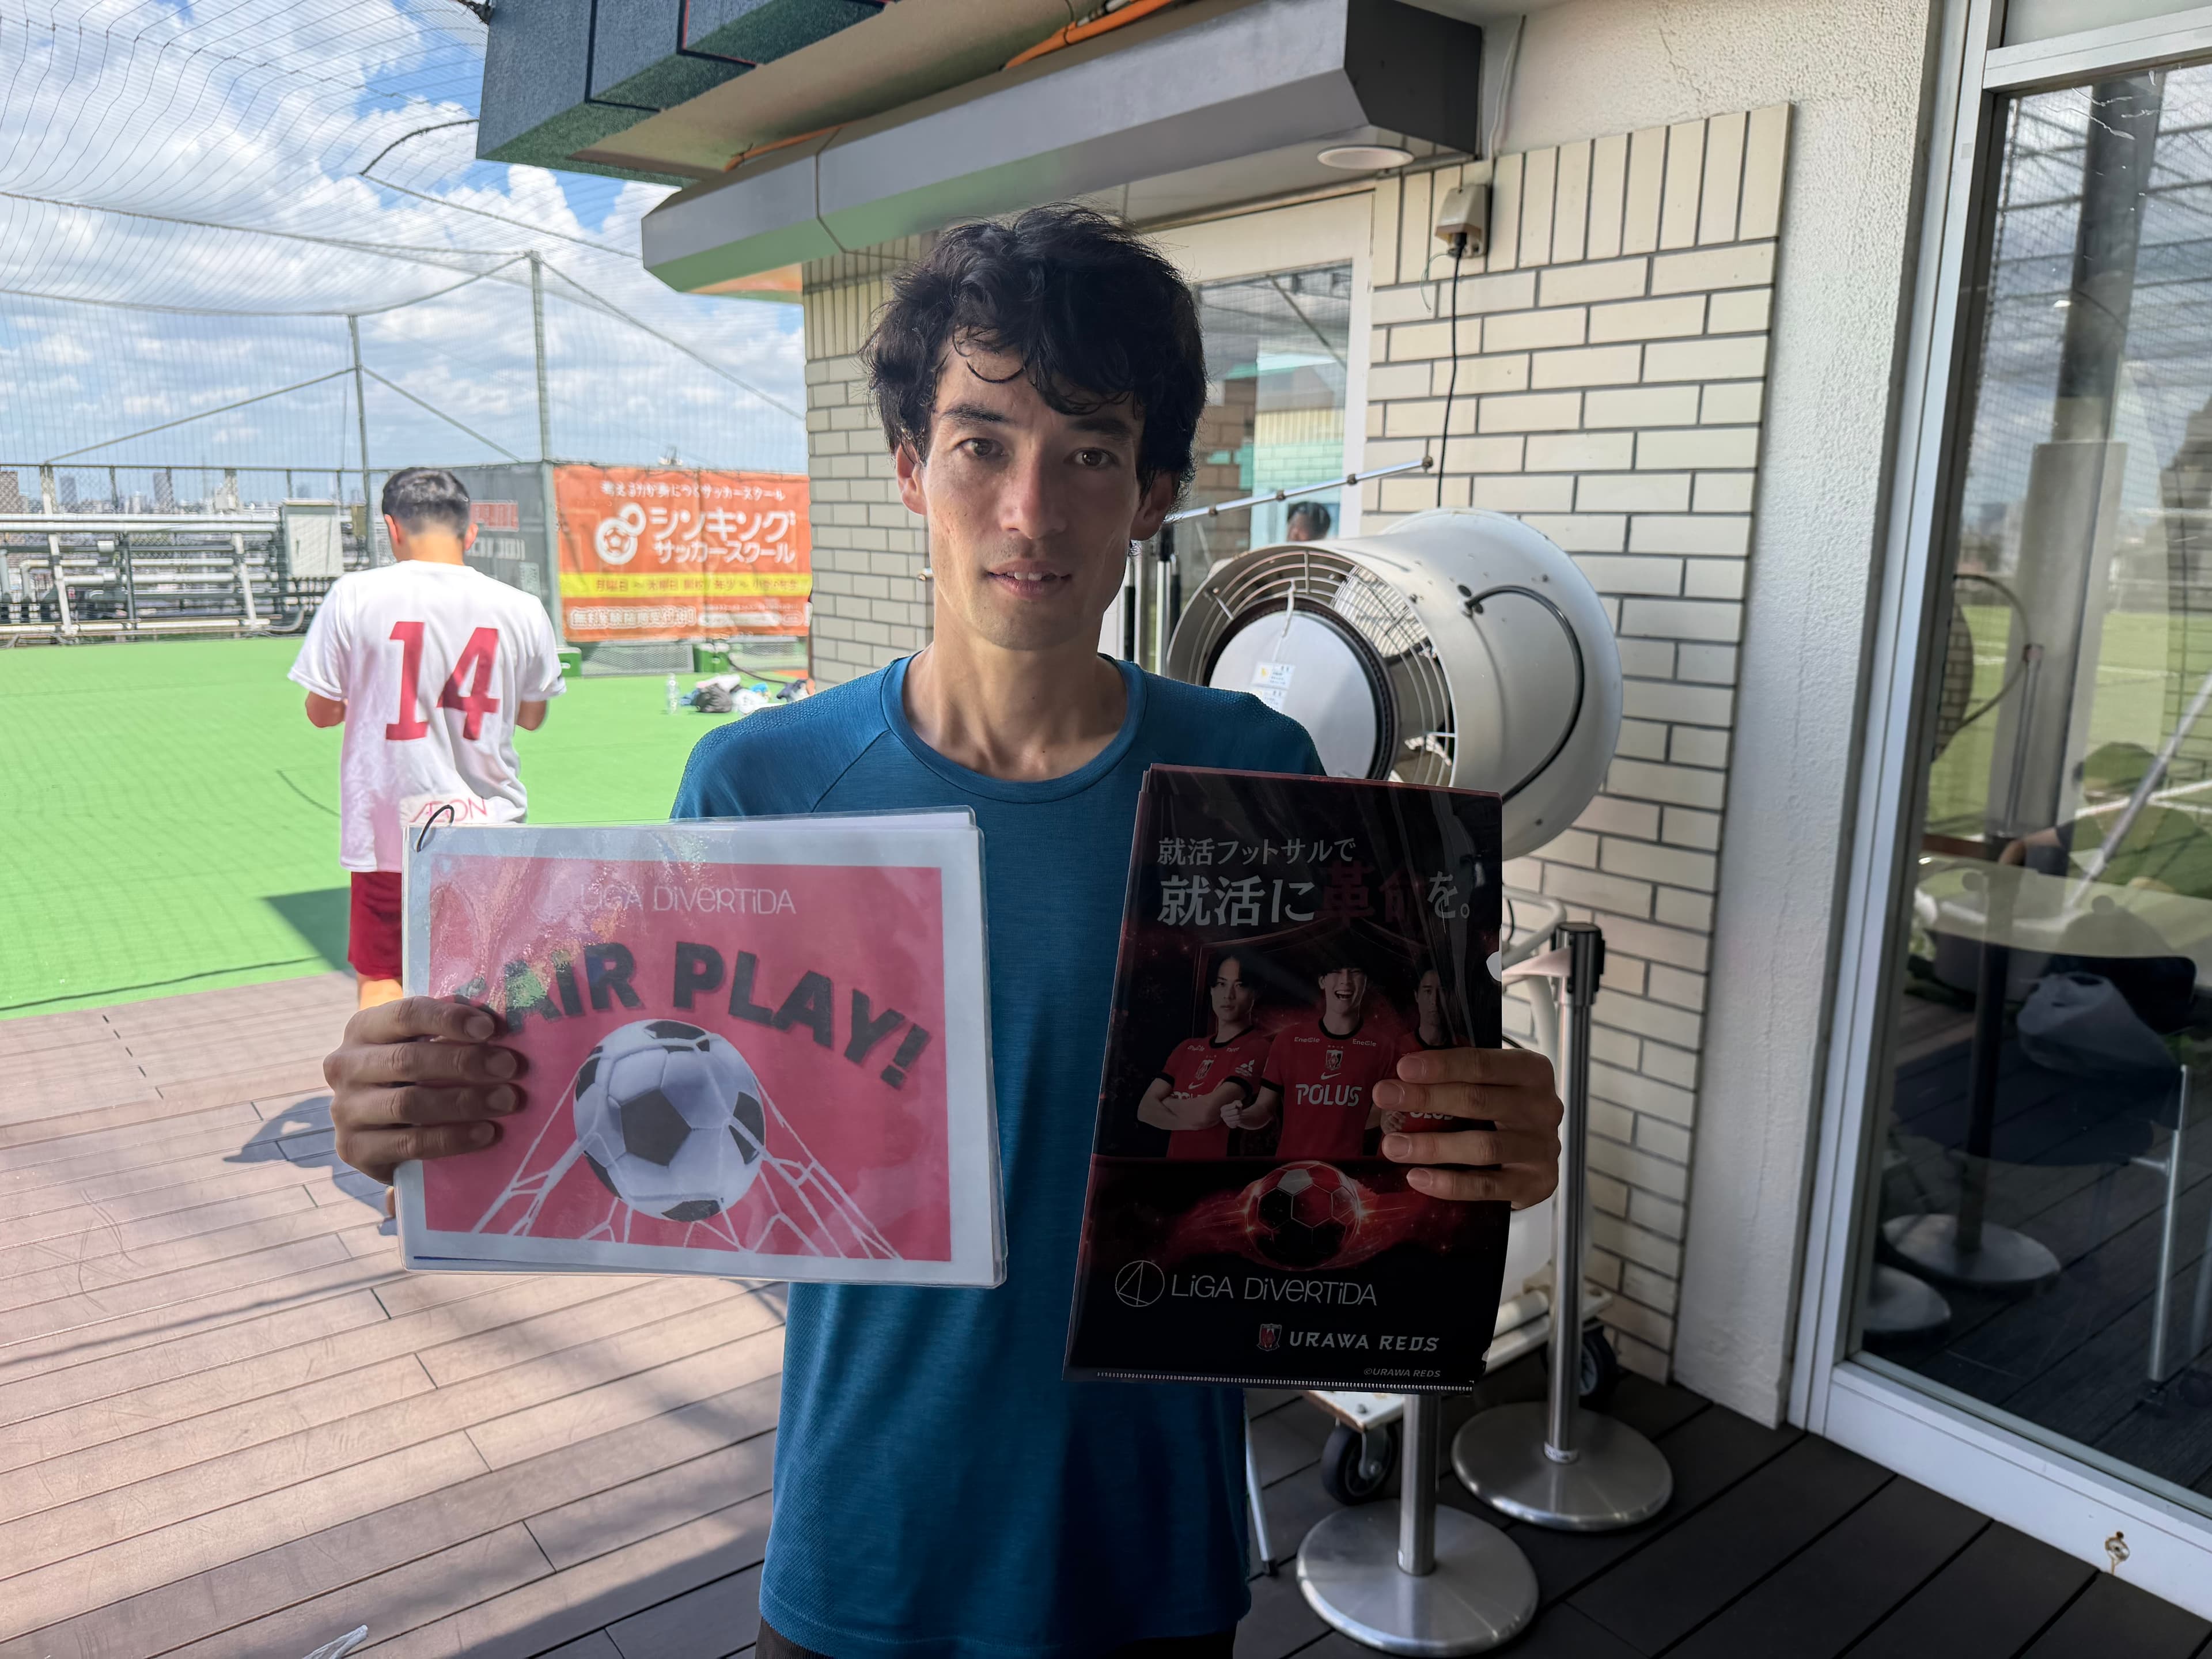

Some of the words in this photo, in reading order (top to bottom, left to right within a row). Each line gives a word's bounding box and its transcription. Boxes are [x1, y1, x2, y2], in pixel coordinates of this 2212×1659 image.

[649, 506, 796, 543] シンキング
[654, 539, 796, 564] サッカースクール
[386, 622, 500, 741] 14
[1157, 837, 1357, 866] 就活フットサルで
[673, 941, 931, 1090] PLAY!
[1296, 1084, 1362, 1107] POLUS
[1289, 1331, 1369, 1350] URAWA
[1378, 1335, 1440, 1352] REDS
[1412, 1369, 1441, 1377] REDS
